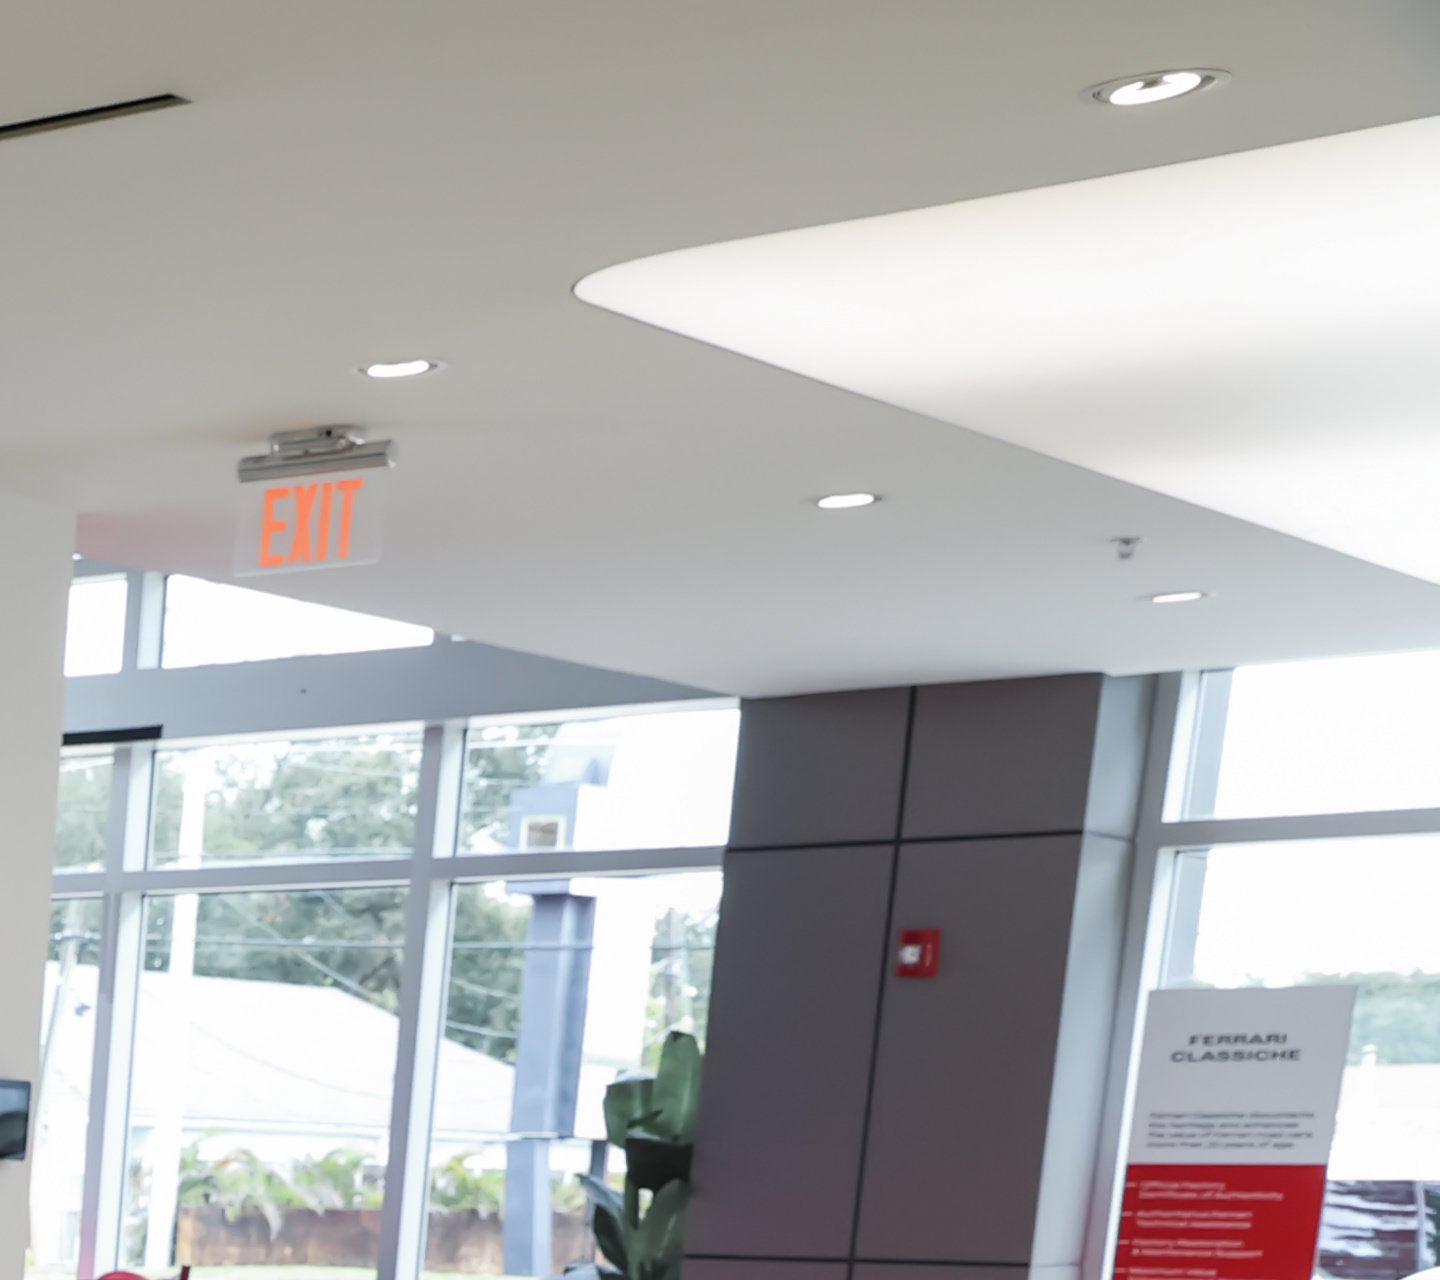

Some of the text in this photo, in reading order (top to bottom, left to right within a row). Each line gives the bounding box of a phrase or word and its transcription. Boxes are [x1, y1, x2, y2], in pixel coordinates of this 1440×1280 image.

[259, 478, 364, 568] EXIT
[1188, 1034, 1287, 1046] FERRARI
[1170, 1049, 1301, 1063] CLASSICHE
